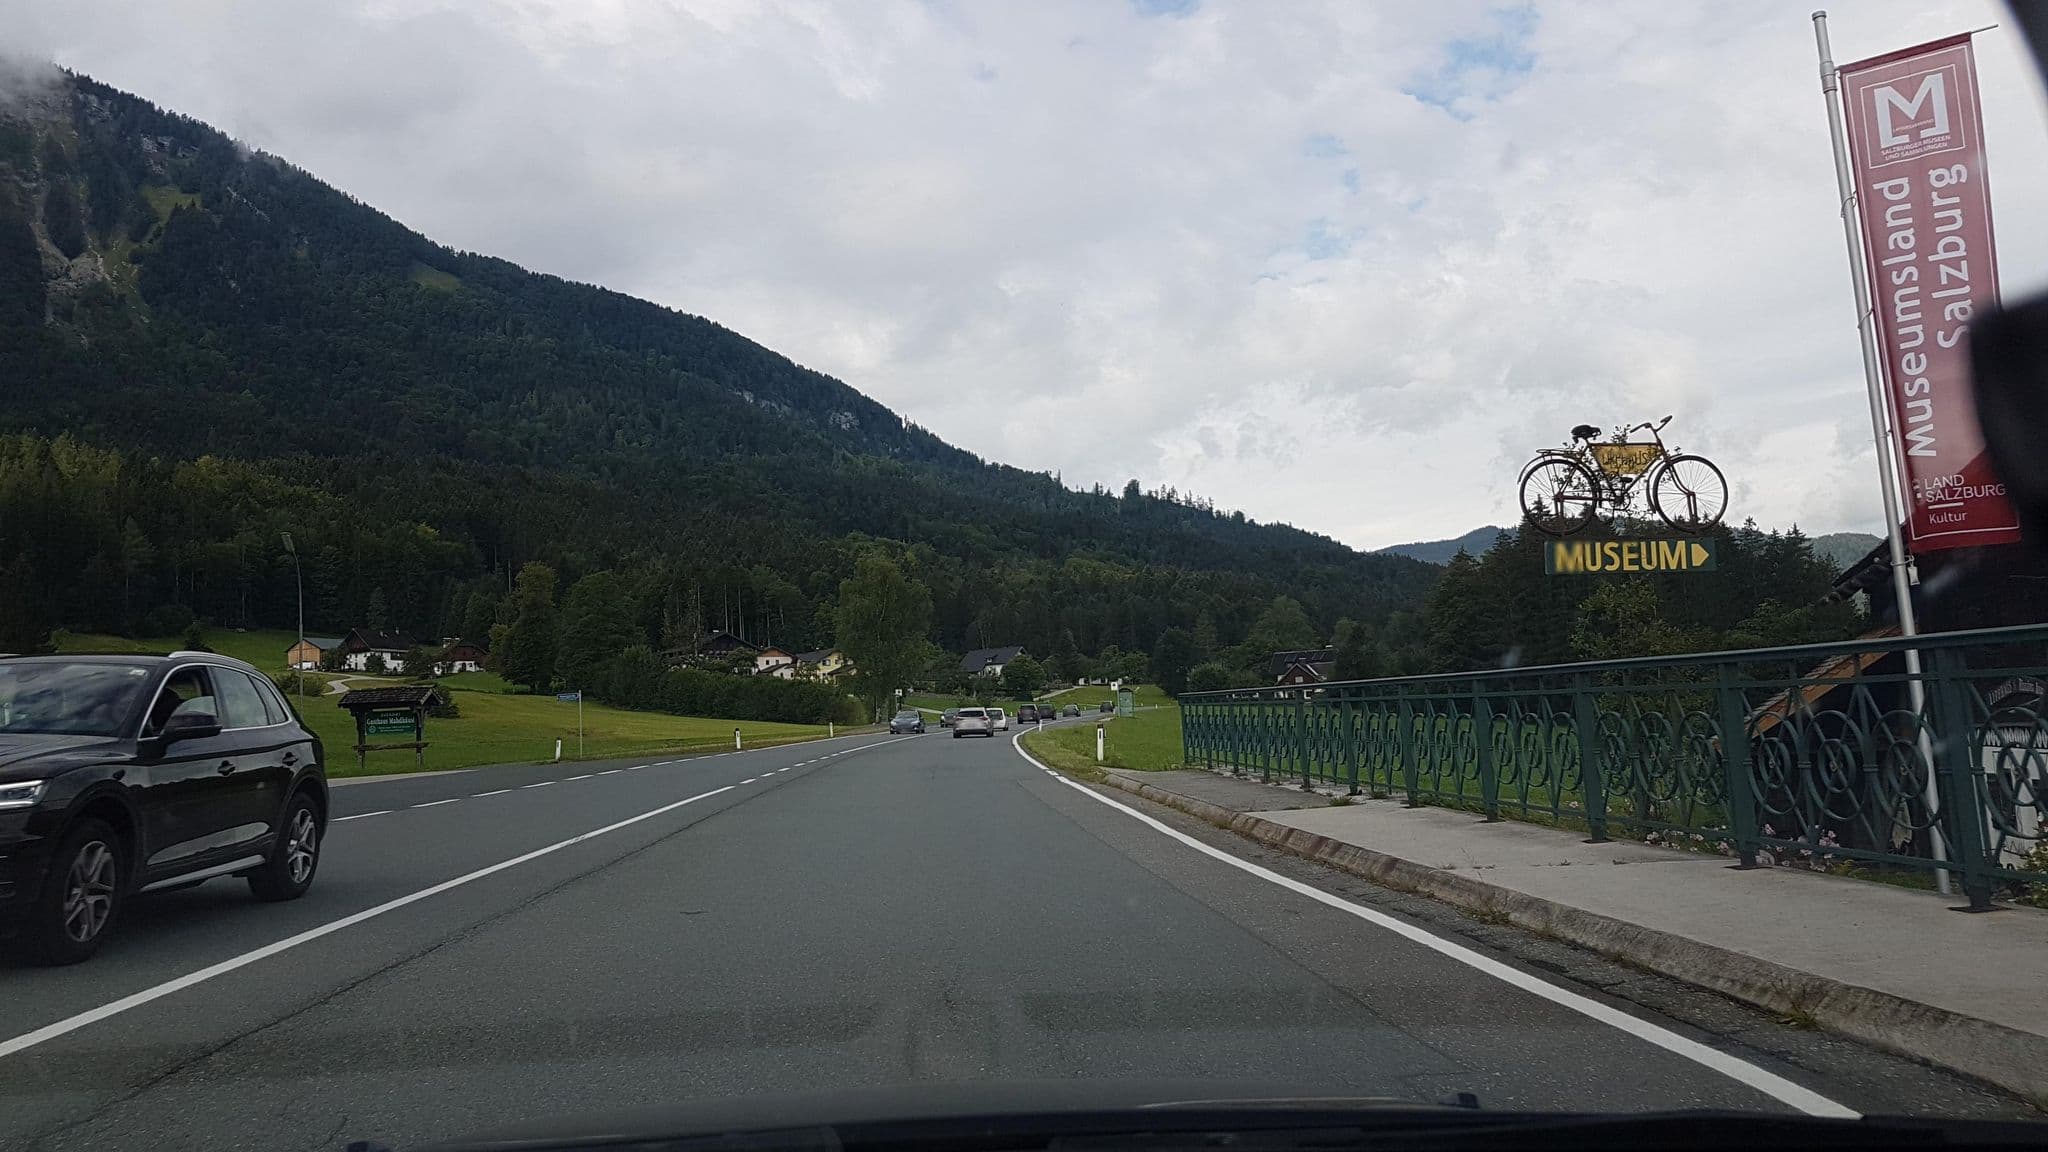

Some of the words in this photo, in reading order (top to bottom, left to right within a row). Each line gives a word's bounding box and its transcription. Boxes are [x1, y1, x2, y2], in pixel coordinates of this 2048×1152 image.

[1874, 73, 1950, 148] M
[1927, 163, 1972, 349] Salzburg
[1873, 176, 1936, 457] Museumsland
[1924, 474, 1965, 490] LAND
[1925, 483, 2007, 503] SALZBURG
[1928, 511, 1967, 525] Kultur
[1554, 540, 1688, 572] MUSEUM
